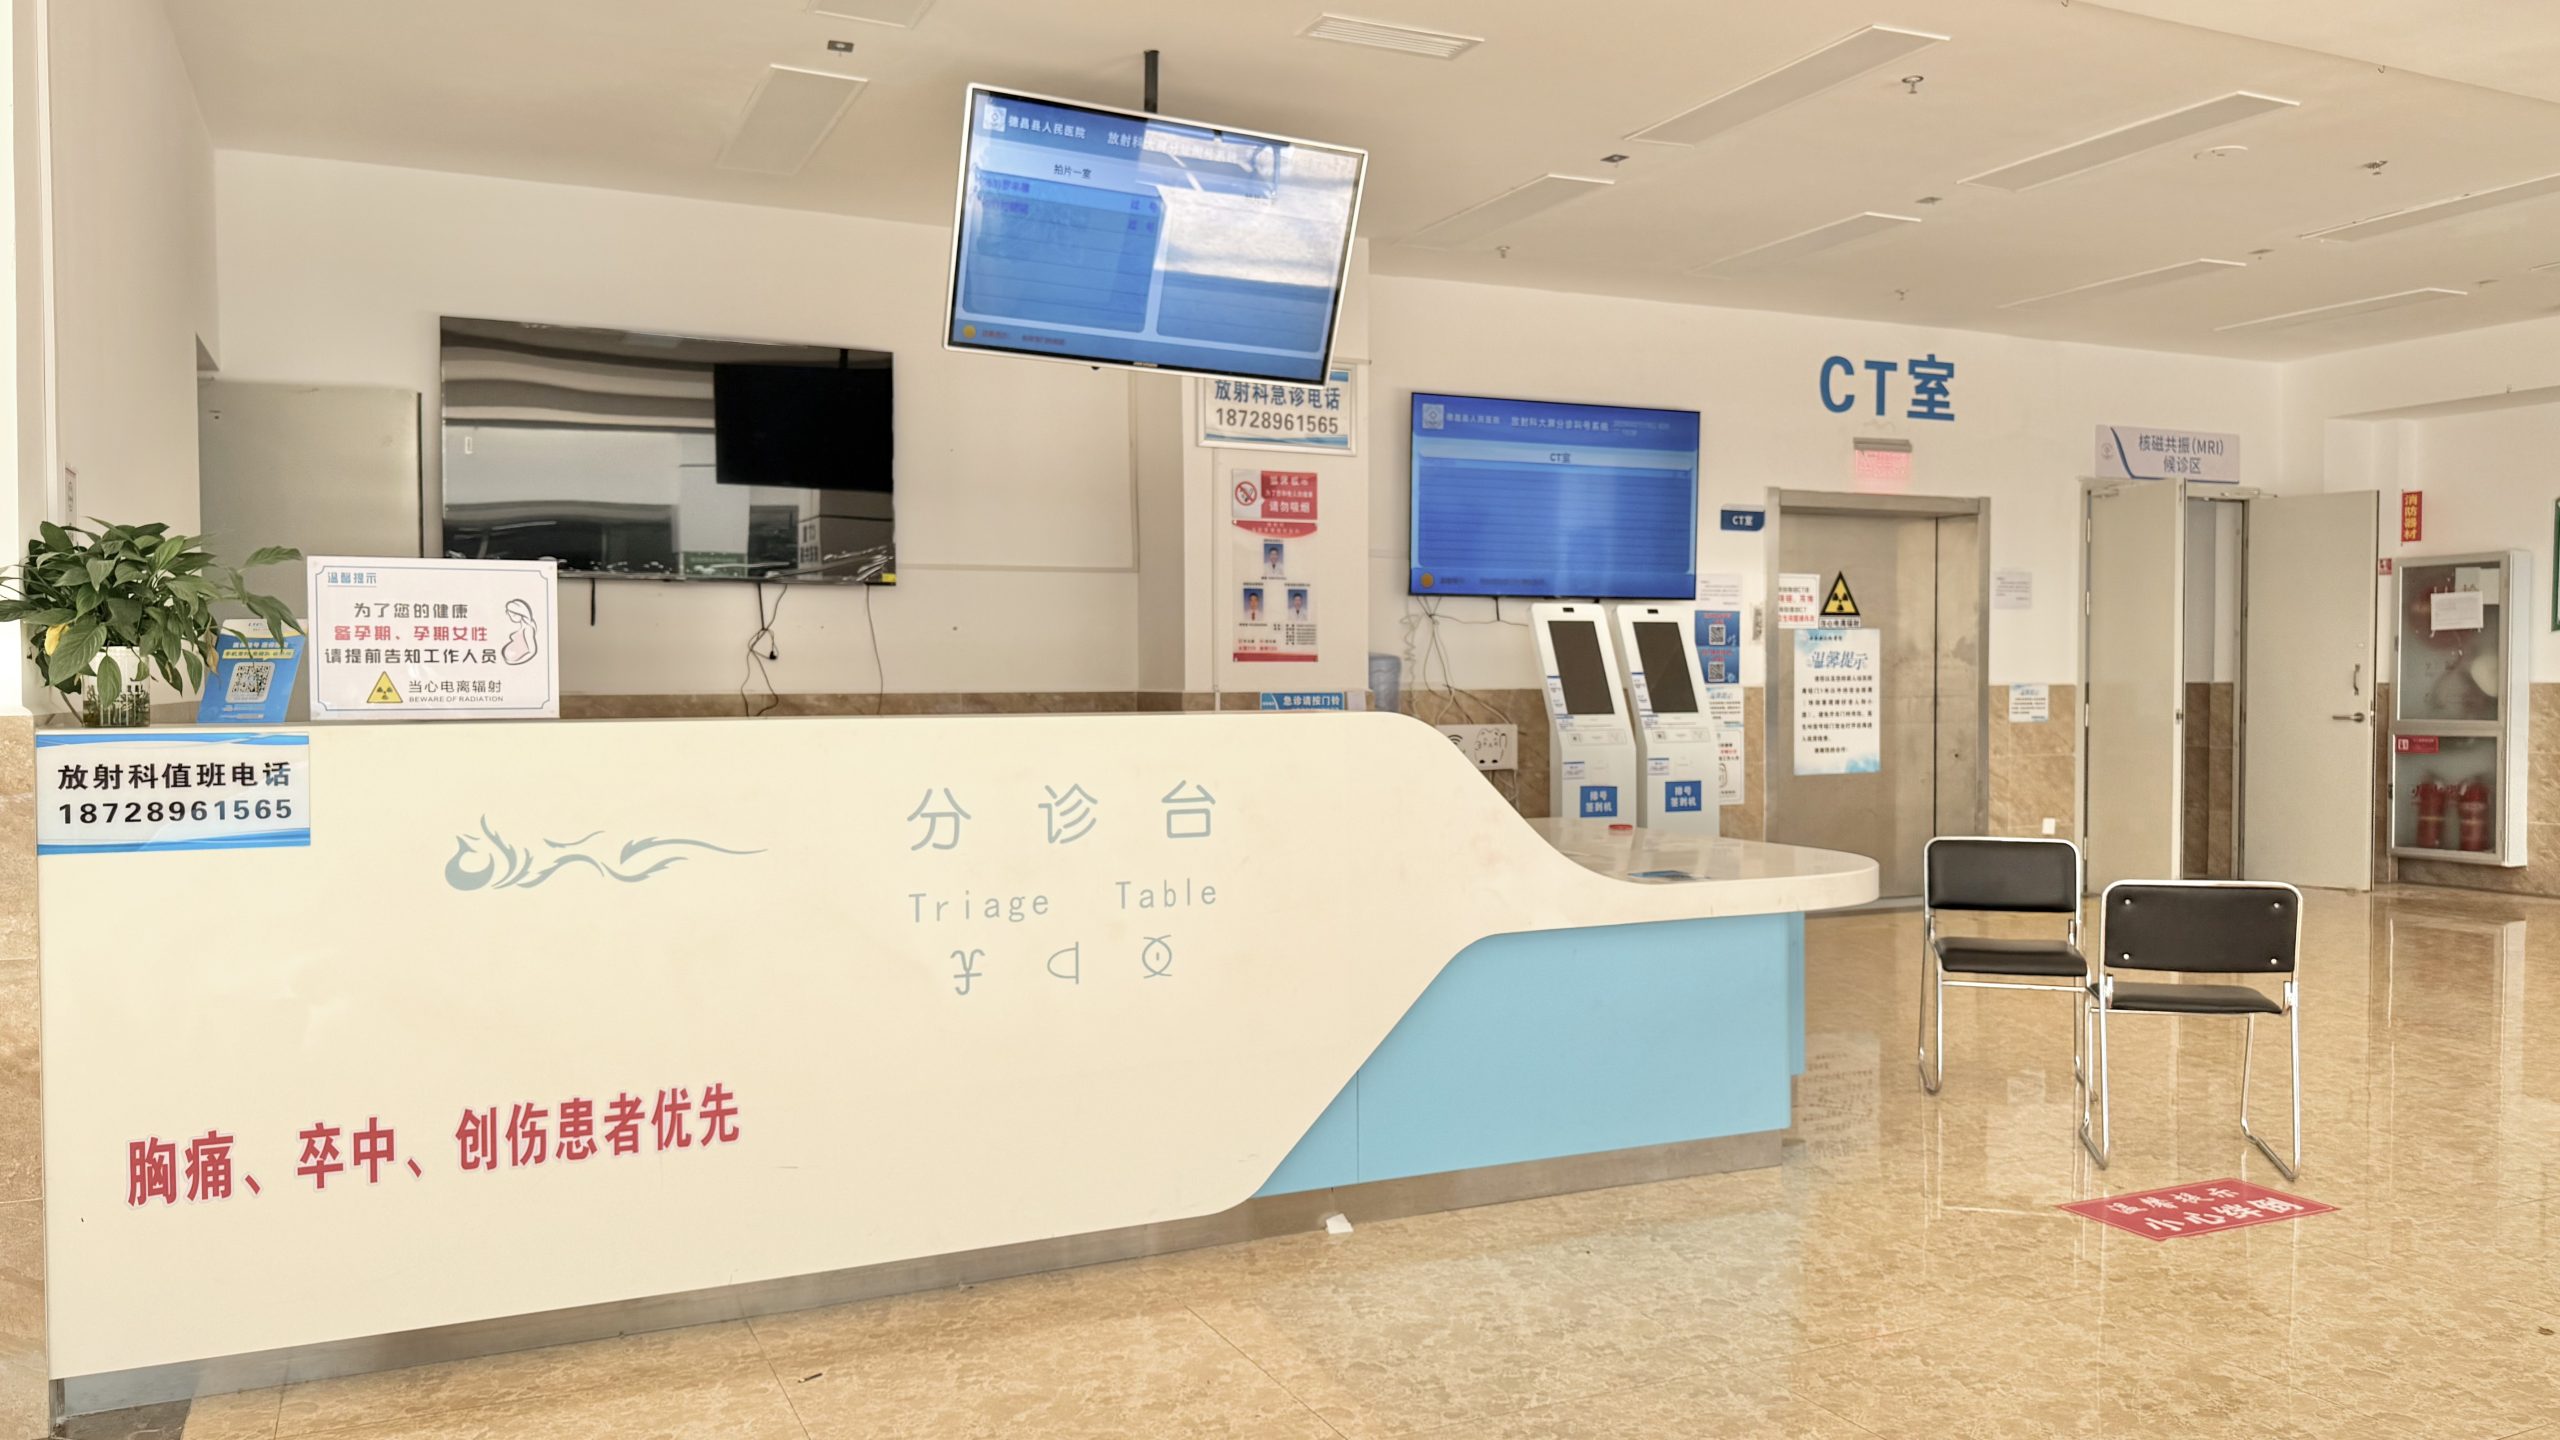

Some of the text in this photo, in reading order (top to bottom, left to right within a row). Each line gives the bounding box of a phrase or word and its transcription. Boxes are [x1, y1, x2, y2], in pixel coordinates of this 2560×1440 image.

[1054, 163, 1093, 180] 拍片一室
[1215, 380, 1341, 411] 放射科急诊电话
[1819, 353, 1955, 421] CT室
[1216, 408, 1338, 434] 18728961565
[1550, 452, 1571, 464] CT室
[2163, 455, 2202, 475] 候诊区
[1269, 500, 1310, 513] 请勿吸烟
[1732, 515, 1753, 526] CT室
[2404, 495, 2418, 540] 消防器材
[327, 572, 377, 584] 温馨提示
[354, 603, 469, 619] 为了您的健康
[334, 625, 488, 642] 备孕期、孕期女性
[325, 648, 497, 665] 请提前告知工作人员
[1811, 650, 1868, 671] 温馨提示
[409, 680, 502, 694] 当心电离辐射
[57, 761, 292, 791] 放射科值班电话
[58, 798, 293, 825] 18728961565
[907, 780, 1216, 851] 分诊台
[908, 877, 1217, 923] Triage Table
[127, 1082, 740, 1207] 胸痛、卒中、创伤患者优先
[2144, 1197, 2305, 1232] 小心绊倒
